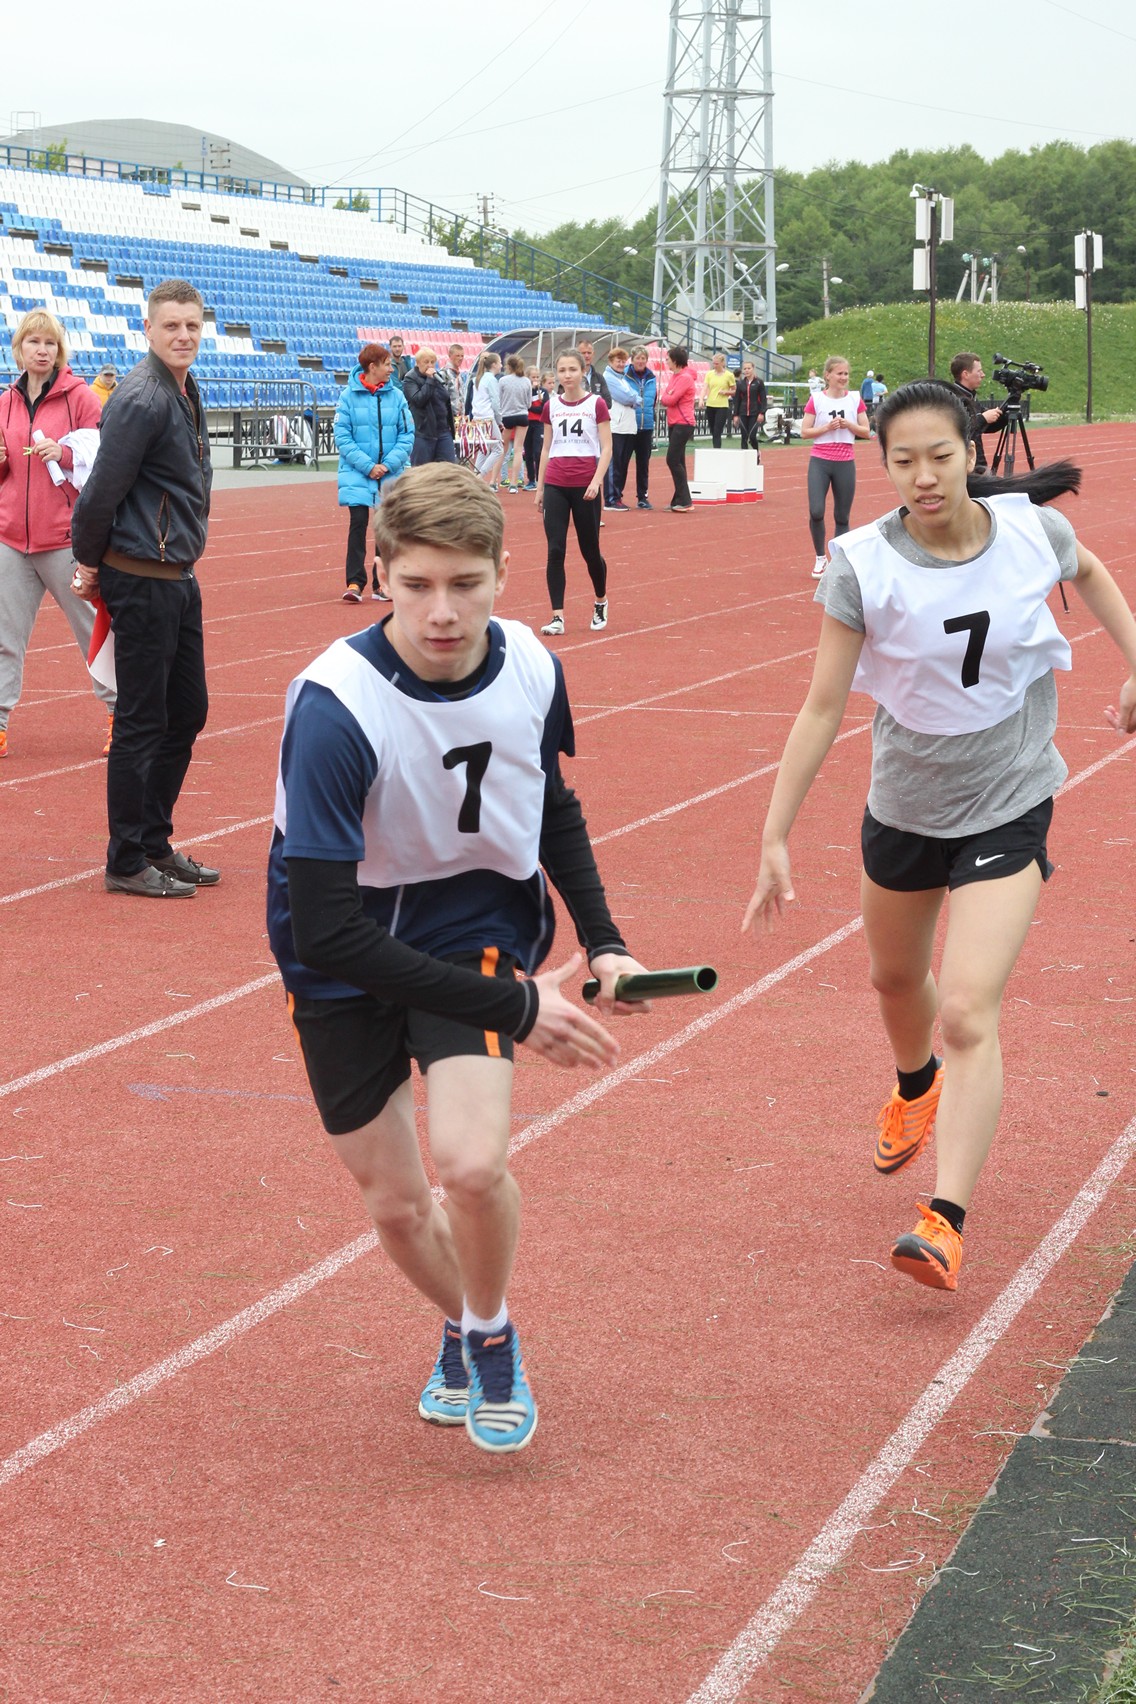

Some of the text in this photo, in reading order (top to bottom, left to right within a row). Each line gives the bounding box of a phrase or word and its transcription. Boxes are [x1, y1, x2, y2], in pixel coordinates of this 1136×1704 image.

[558, 418, 584, 437] 14
[828, 409, 845, 419] 11
[943, 610, 991, 689] 7
[442, 741, 493, 833] 7
